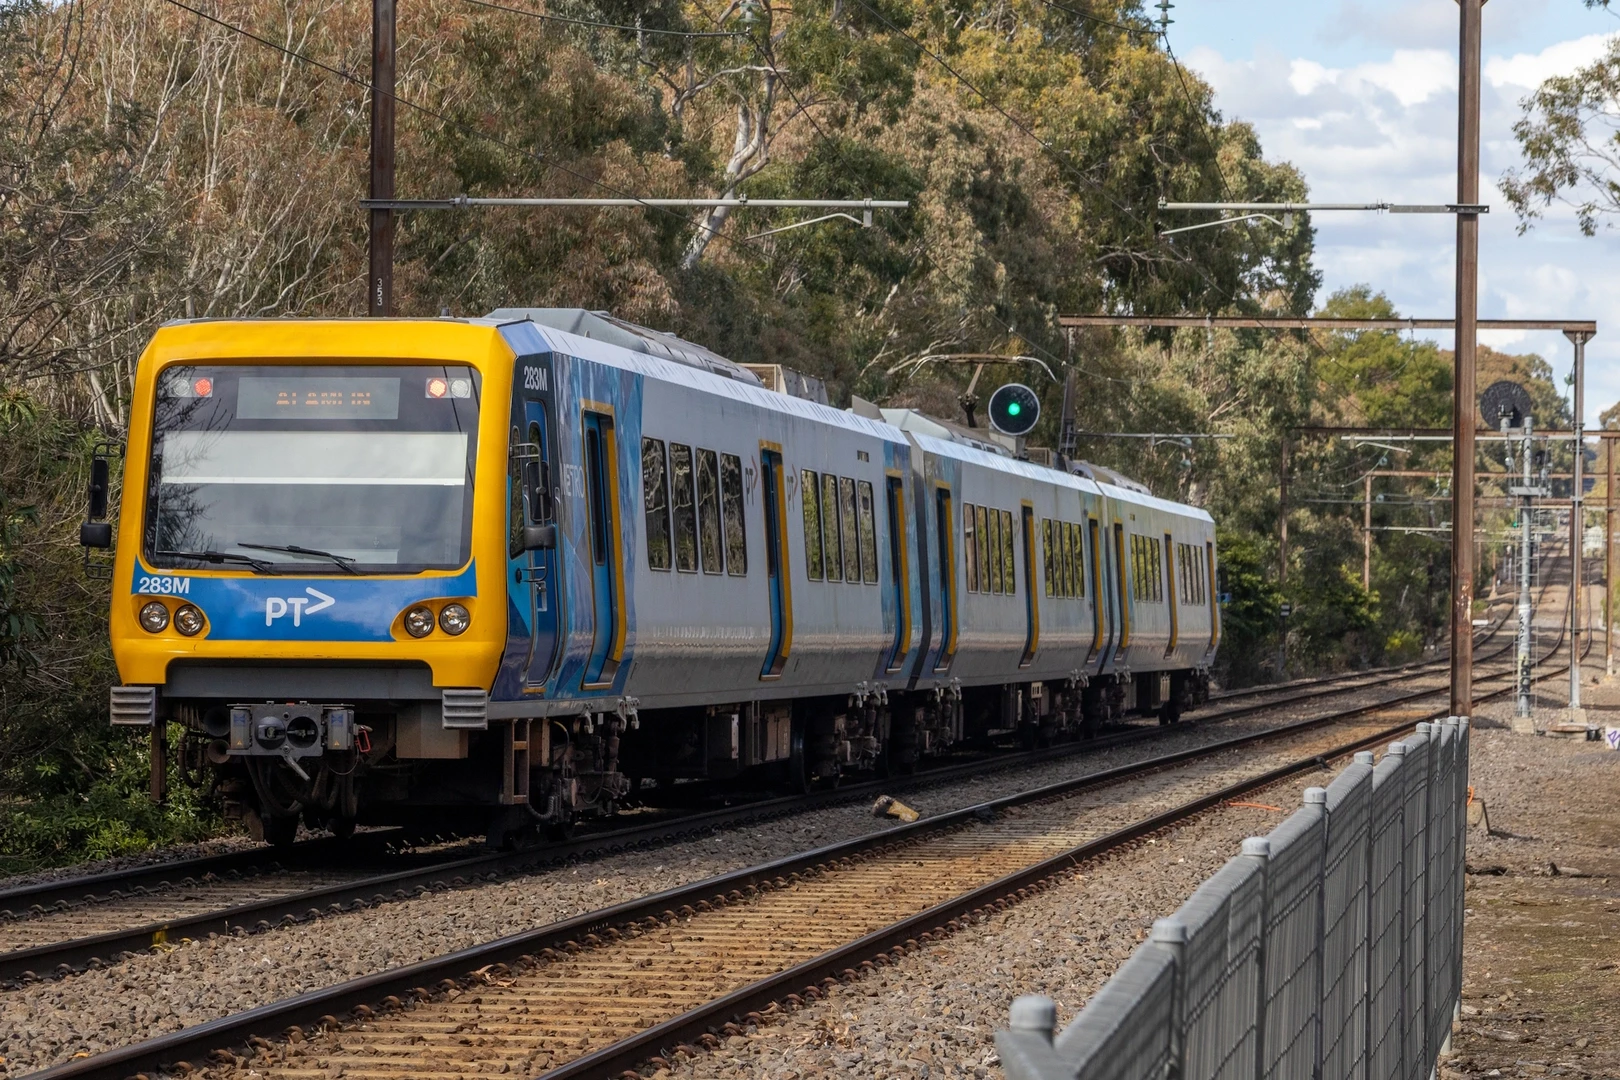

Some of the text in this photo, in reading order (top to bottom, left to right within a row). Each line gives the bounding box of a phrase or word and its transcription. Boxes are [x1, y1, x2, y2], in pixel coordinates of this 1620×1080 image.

[523, 365, 548, 391] 283M
[138, 576, 190, 594] 283M
[265, 597, 309, 627] PT
